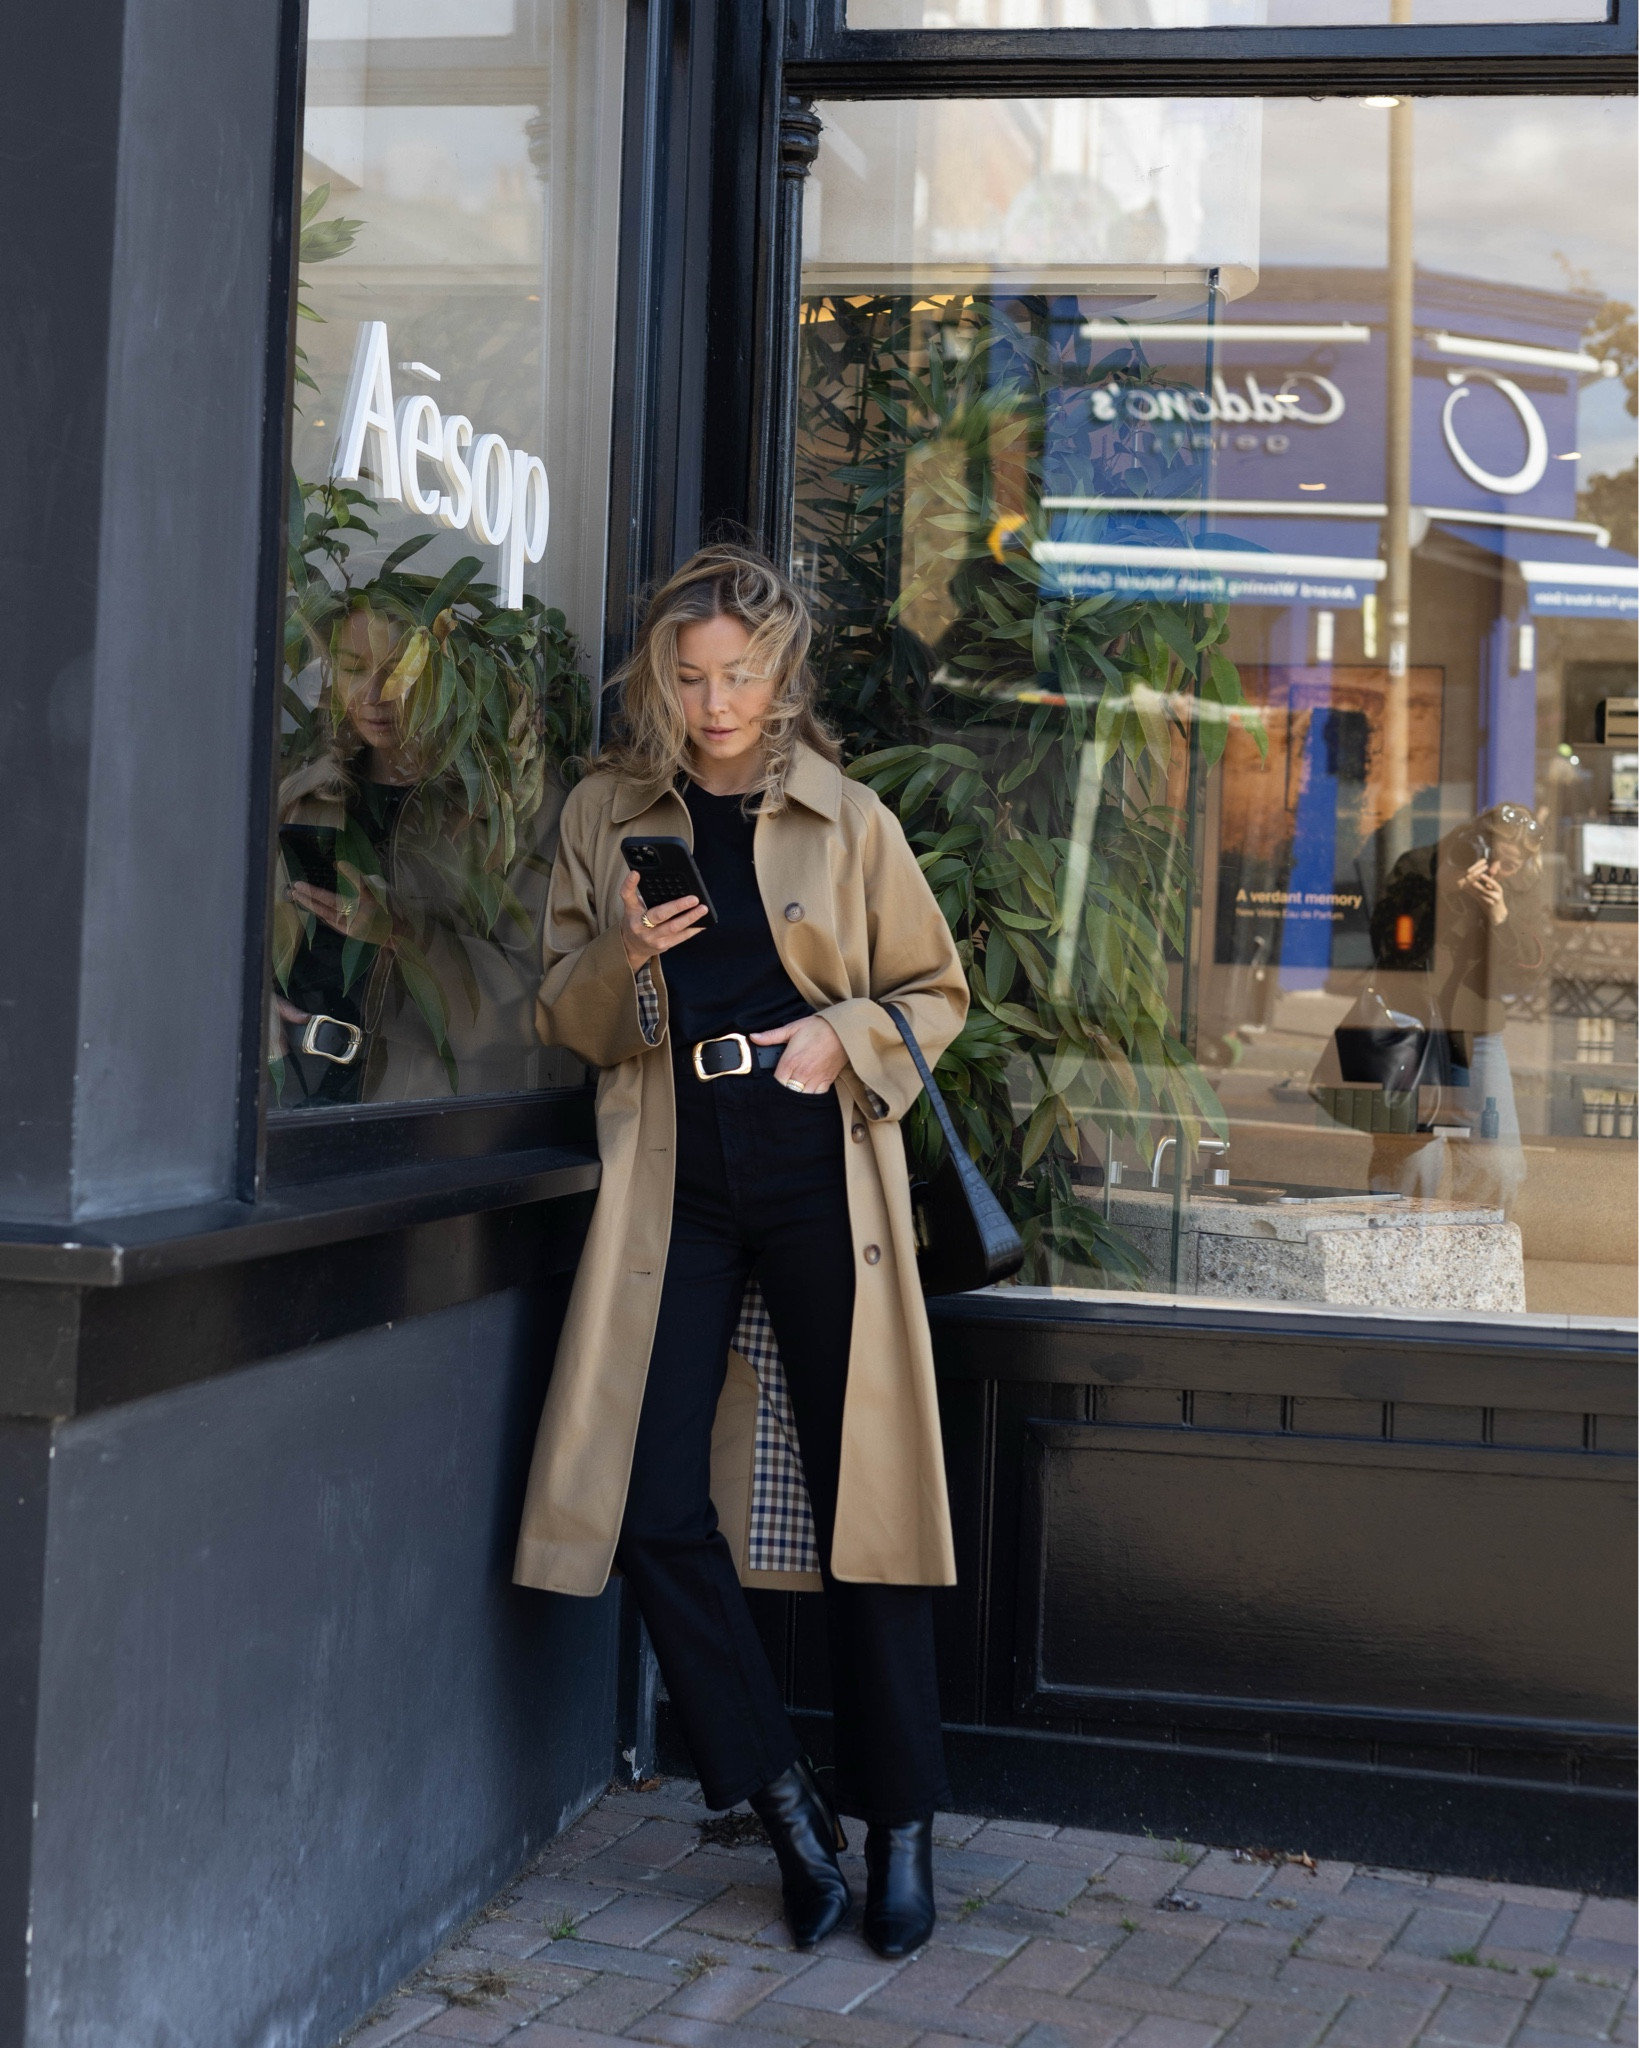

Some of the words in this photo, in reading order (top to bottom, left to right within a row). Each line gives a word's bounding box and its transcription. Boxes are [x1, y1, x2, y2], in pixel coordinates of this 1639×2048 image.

[1236, 888, 1248, 902] A
[1250, 890, 1303, 904] verdant
[1305, 892, 1363, 909] memory
